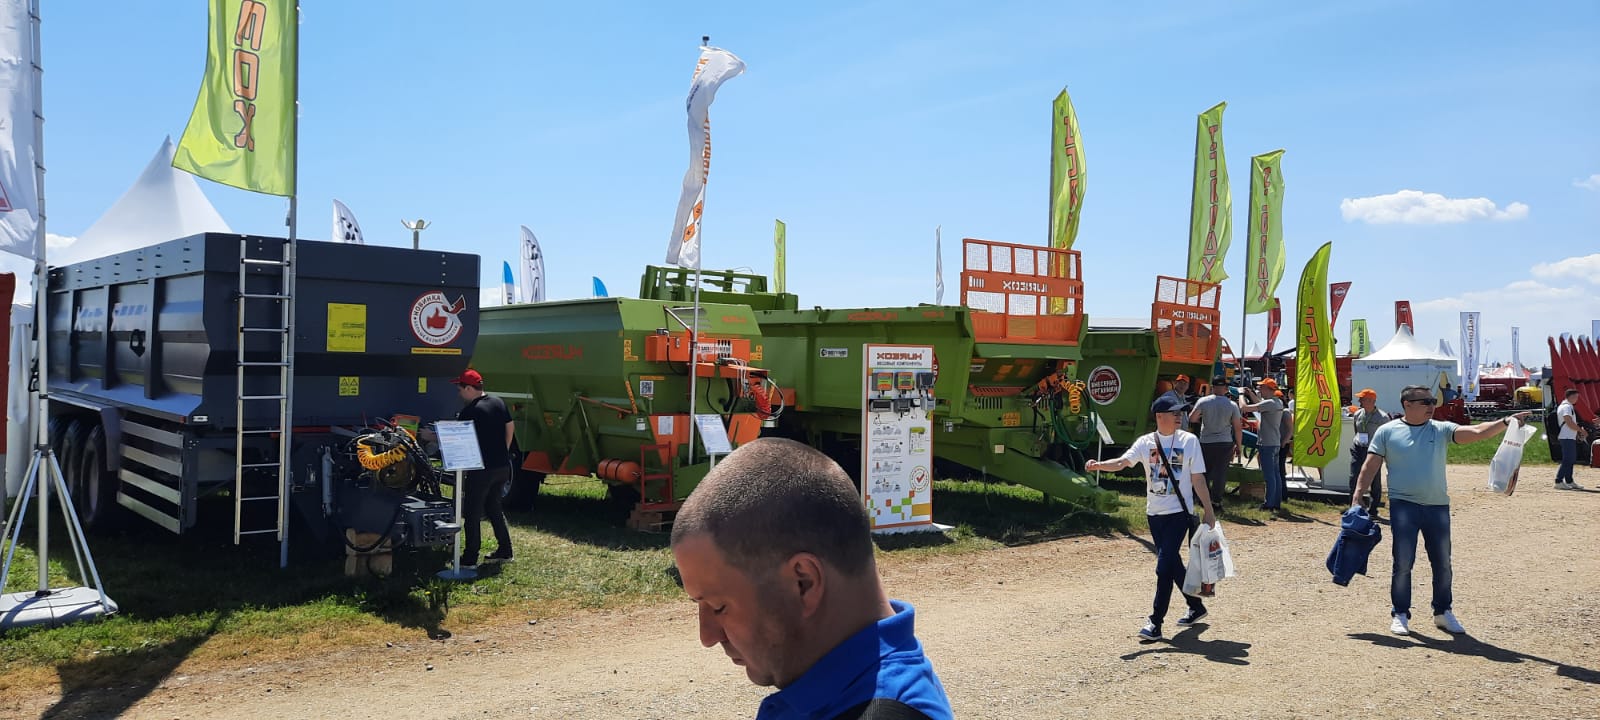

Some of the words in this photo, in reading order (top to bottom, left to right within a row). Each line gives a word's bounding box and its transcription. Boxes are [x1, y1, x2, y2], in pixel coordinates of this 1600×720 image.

[413, 295, 441, 316] НОВИНКА
[876, 352, 922, 361] ХОЗЯИН
[1304, 306, 1335, 457] ХОЗЯИ
